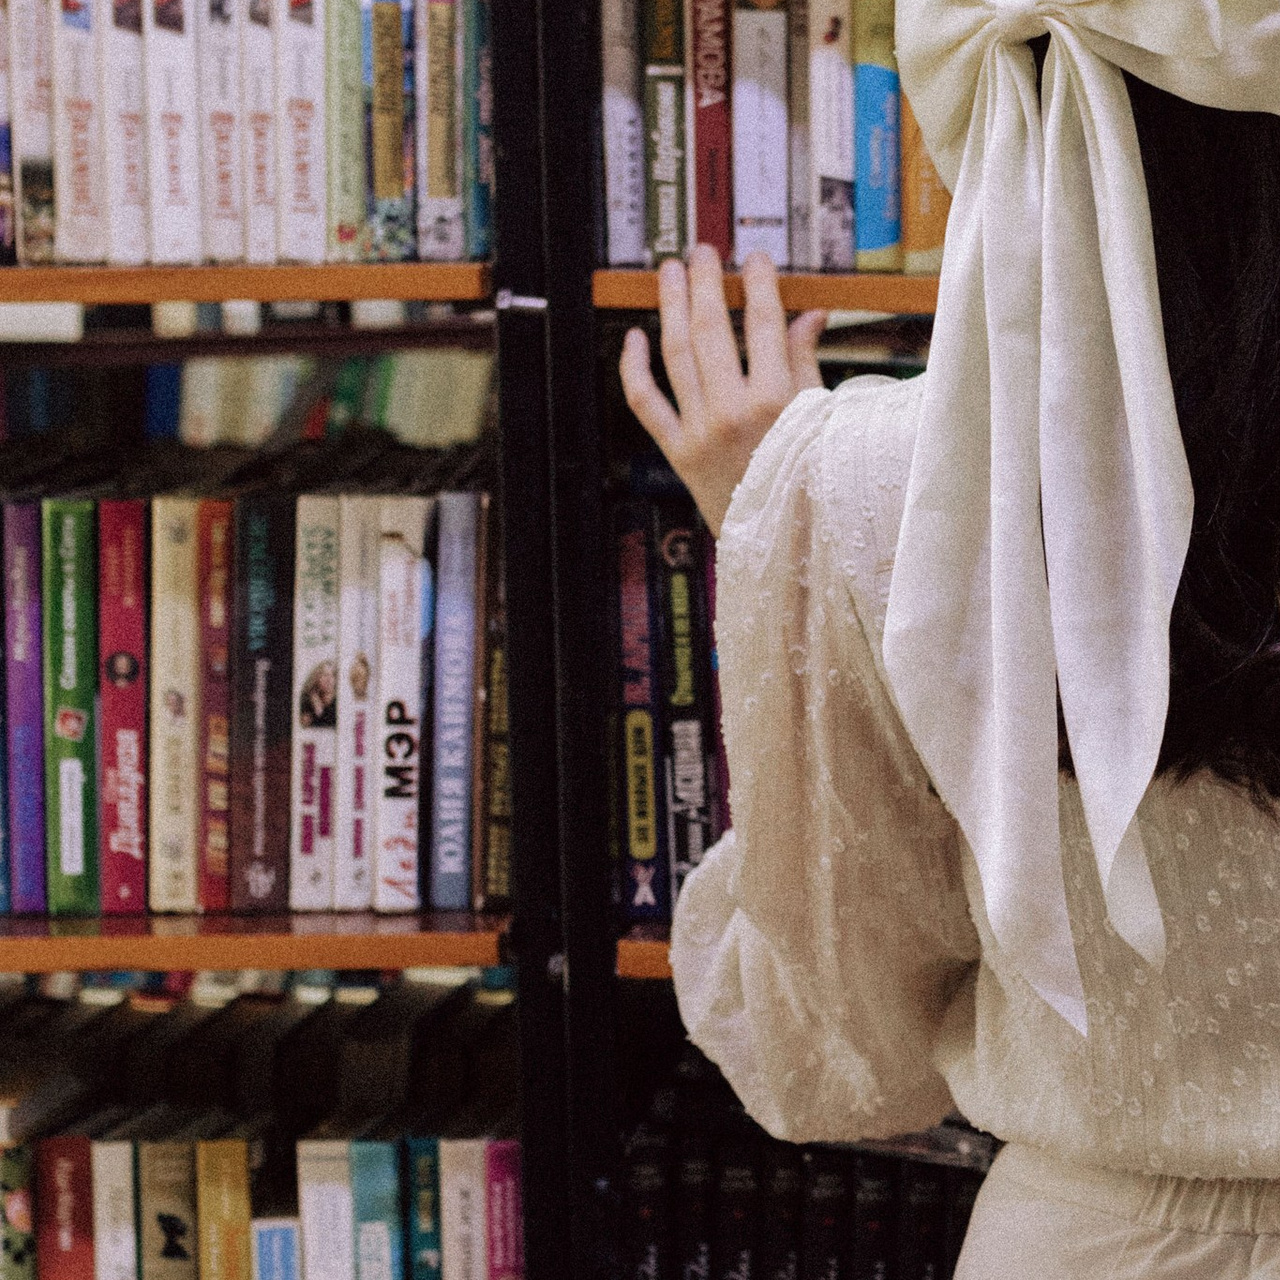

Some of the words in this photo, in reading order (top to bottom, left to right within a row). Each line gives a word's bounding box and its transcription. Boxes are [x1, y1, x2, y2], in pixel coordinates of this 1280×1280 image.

[440, 612, 470, 768] КЛИМОВА
[382, 697, 417, 801] МЭР
[439, 774, 469, 875] ЮЛИЯ
